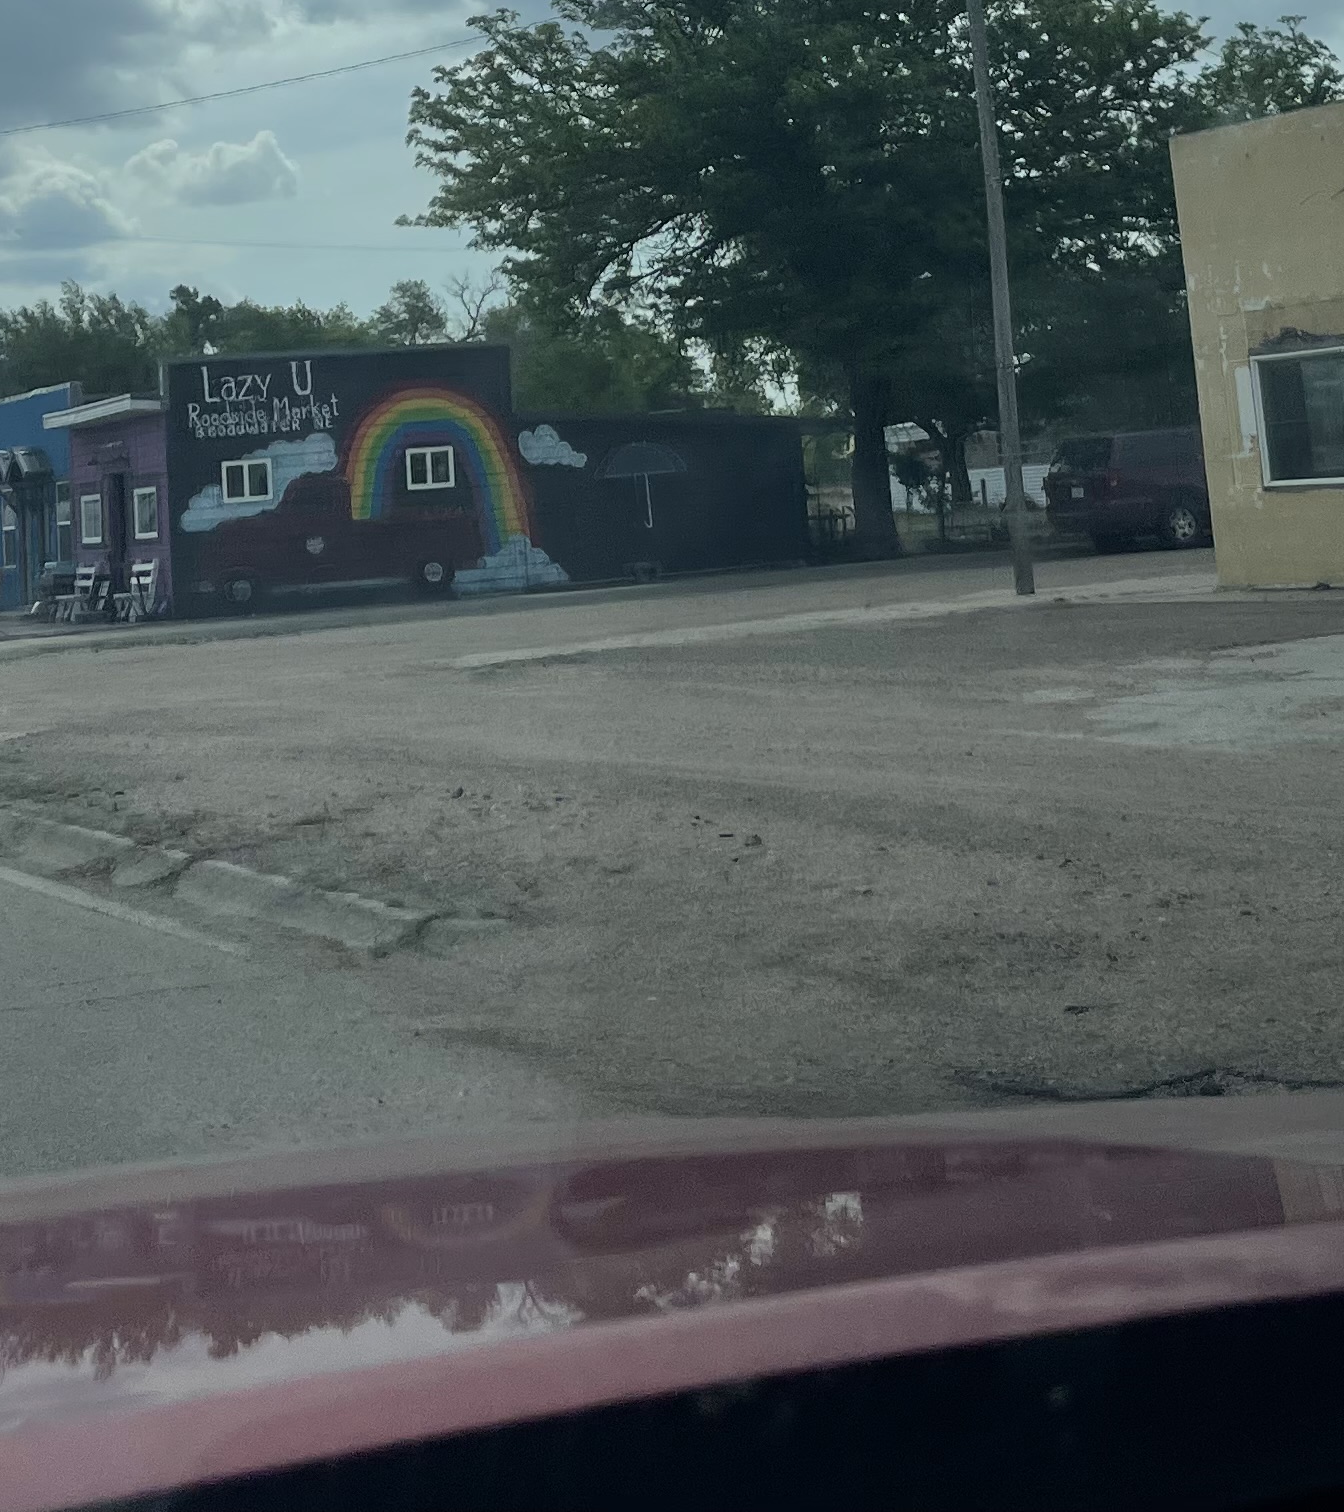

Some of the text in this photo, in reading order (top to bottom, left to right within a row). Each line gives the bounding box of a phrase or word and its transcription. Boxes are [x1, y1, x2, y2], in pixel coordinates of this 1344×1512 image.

[201, 360, 312, 403] Lazy U
[187, 393, 340, 428] Roadside Market
